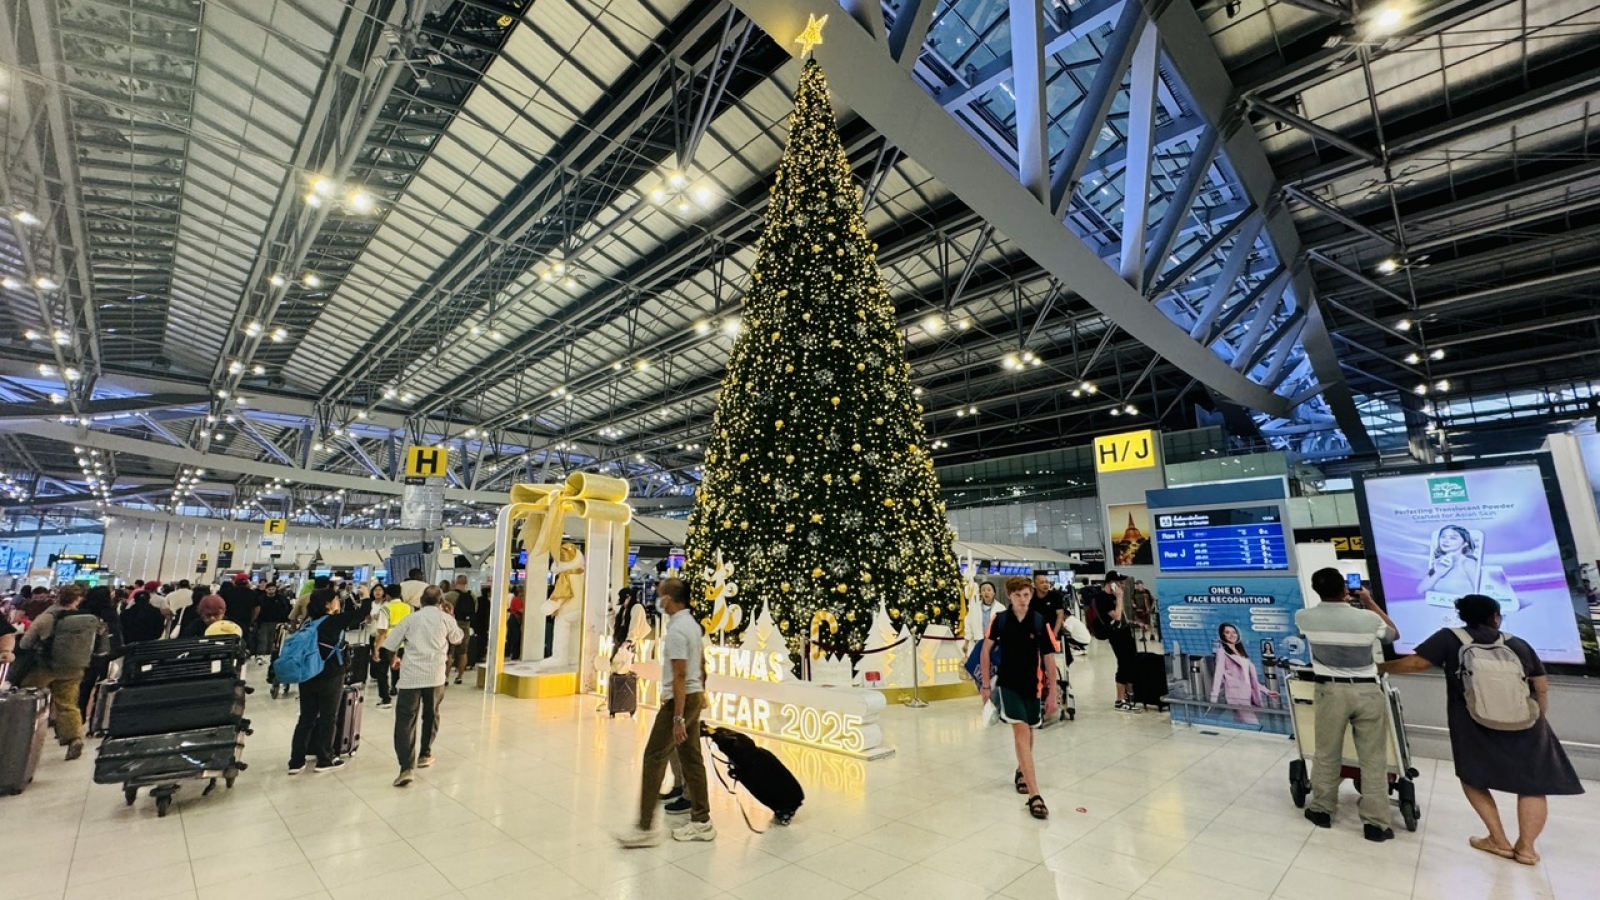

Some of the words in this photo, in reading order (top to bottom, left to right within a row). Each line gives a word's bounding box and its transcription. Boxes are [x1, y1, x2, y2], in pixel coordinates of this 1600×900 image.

[1100, 438, 1149, 465] H/J
[416, 449, 438, 474] H
[1434, 505, 1480, 514] Translucent
[270, 520, 280, 532] F
[1177, 530, 1184, 539] H
[223, 542, 231, 551] D
[1180, 549, 1186, 558] J
[708, 691, 770, 734] YEAR
[781, 704, 864, 752] 2025
